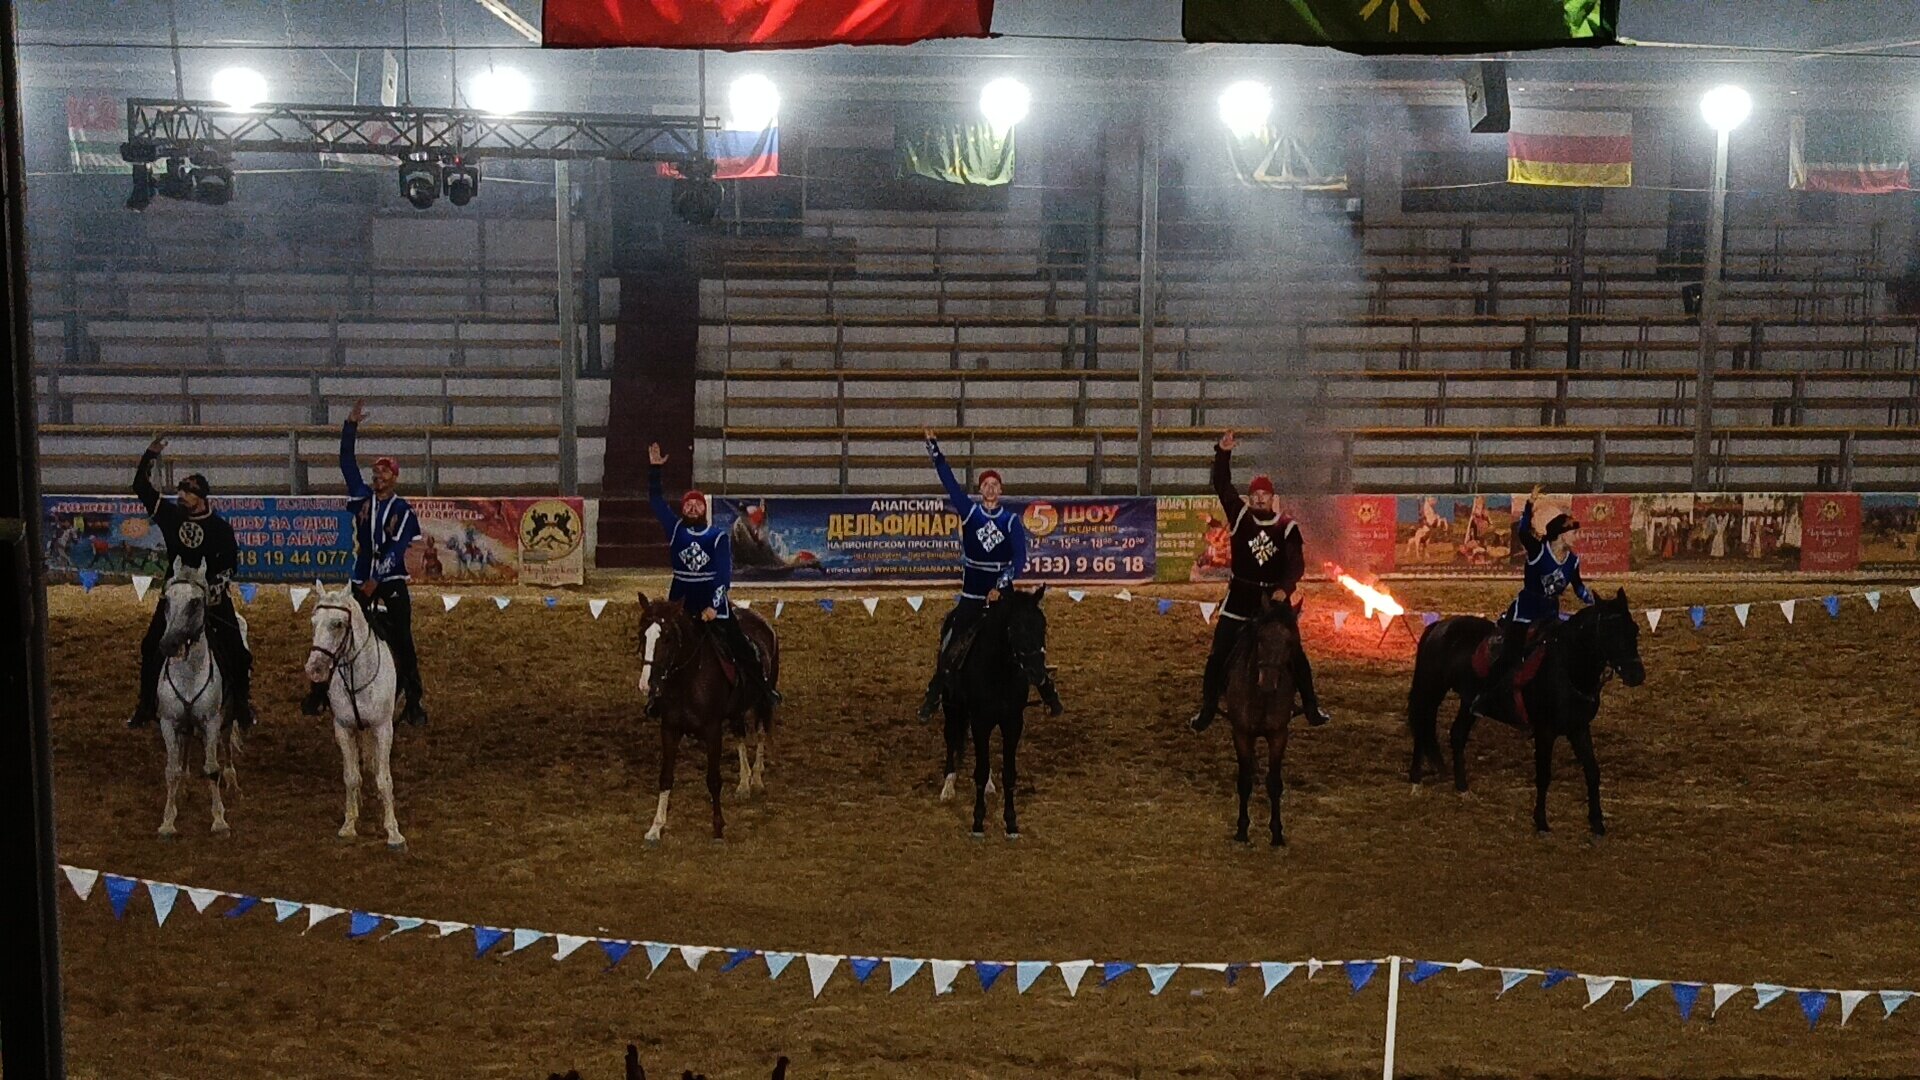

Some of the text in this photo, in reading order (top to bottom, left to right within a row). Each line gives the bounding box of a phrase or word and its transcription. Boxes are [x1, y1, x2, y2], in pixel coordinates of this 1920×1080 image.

[871, 499, 944, 512] АНАПСКИЙ
[229, 516, 338, 531] ШОУ ЗА ОДИН
[1029, 504, 1119, 533] 5 ШОУ
[272, 532, 284, 546] В
[287, 531, 339, 546] АБРАУ
[827, 541, 839, 550] НА
[842, 540, 905, 550] ПИОНЕРСКОМ
[264, 551, 284, 565] 19
[290, 551, 311, 565] 44
[317, 551, 347, 565] 077
[1076, 556, 1087, 572] 9
[1093, 556, 1116, 572] 66
[1122, 556, 1144, 572] 18
